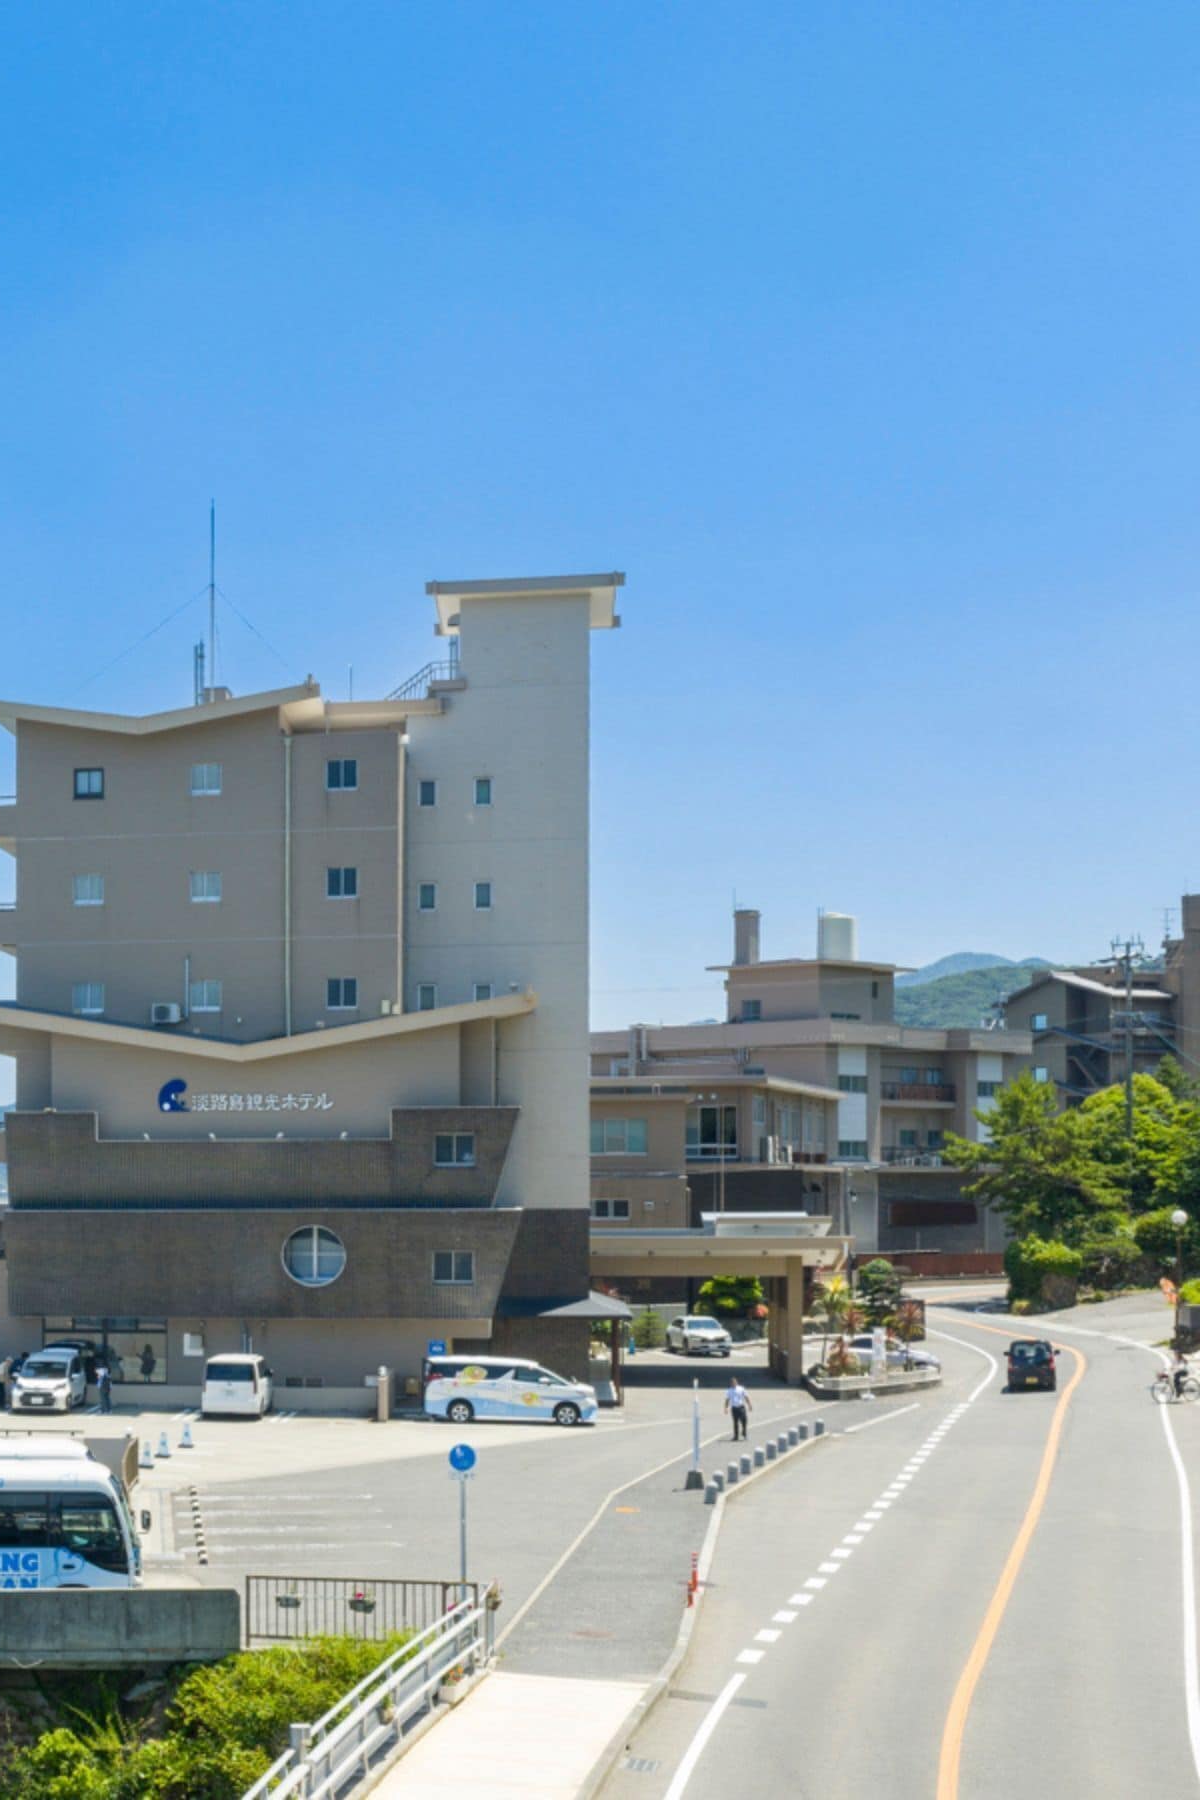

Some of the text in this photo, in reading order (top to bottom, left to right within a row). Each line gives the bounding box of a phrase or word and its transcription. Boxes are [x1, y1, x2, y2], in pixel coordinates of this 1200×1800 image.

[191, 1093, 334, 1111] 淡路島観光ホテル
